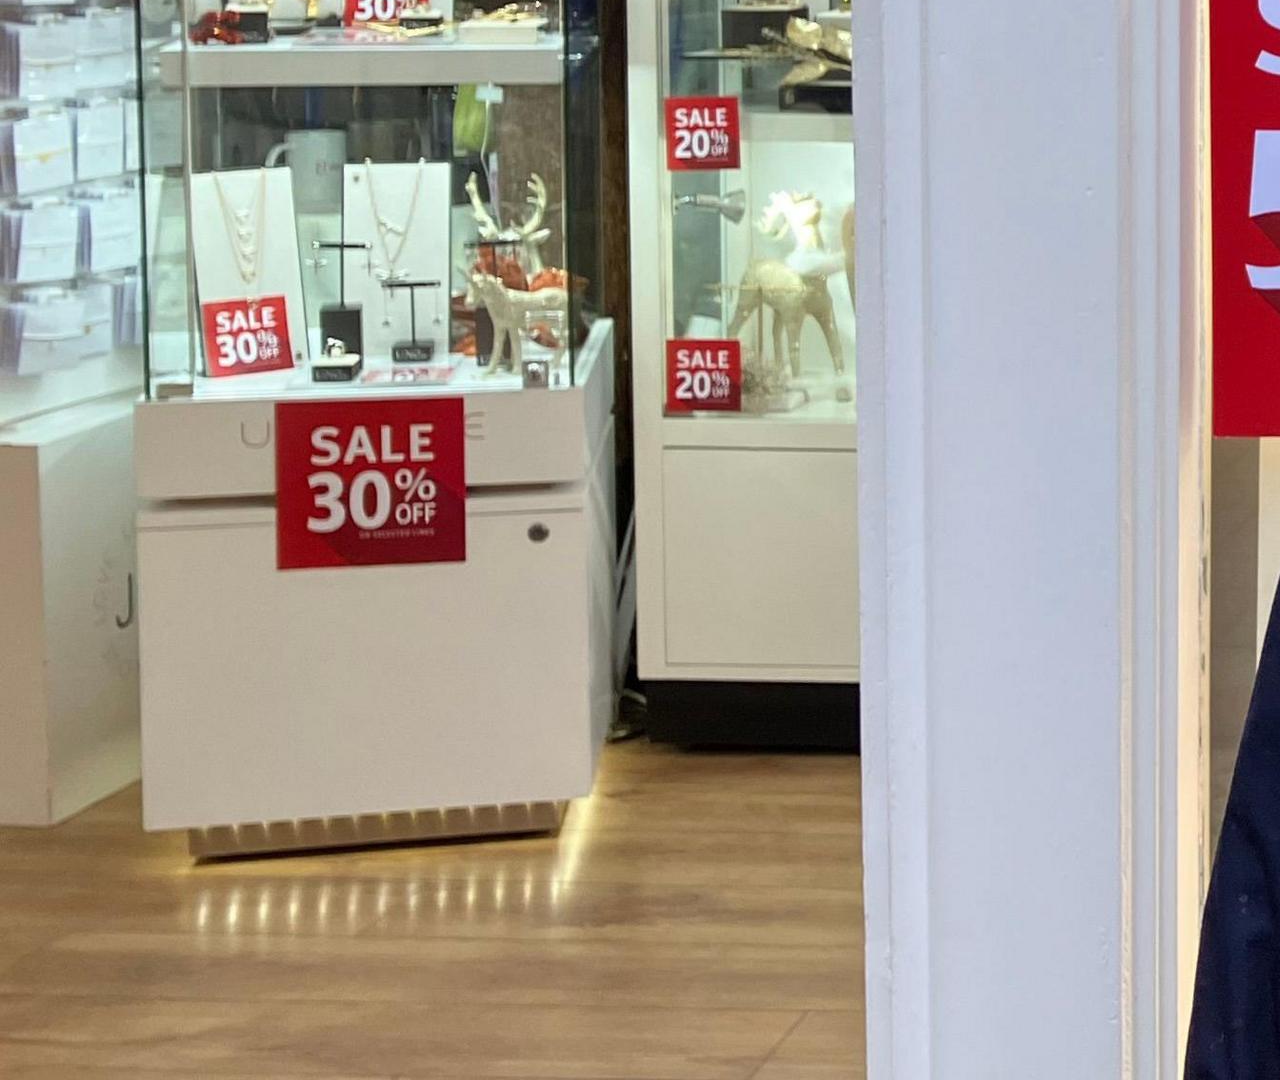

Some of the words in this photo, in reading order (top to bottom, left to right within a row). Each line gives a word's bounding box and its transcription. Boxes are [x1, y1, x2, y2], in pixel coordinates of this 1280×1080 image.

[674, 106, 729, 129] SALE
[673, 127, 729, 160] 20%
[215, 305, 278, 334] SALE
[214, 328, 279, 368] 30%
[676, 348, 730, 370] SALE
[674, 369, 731, 400] 20%
[309, 423, 435, 467] SALE
[306, 467, 437, 534] 30%
[394, 501, 437, 526] OFF
